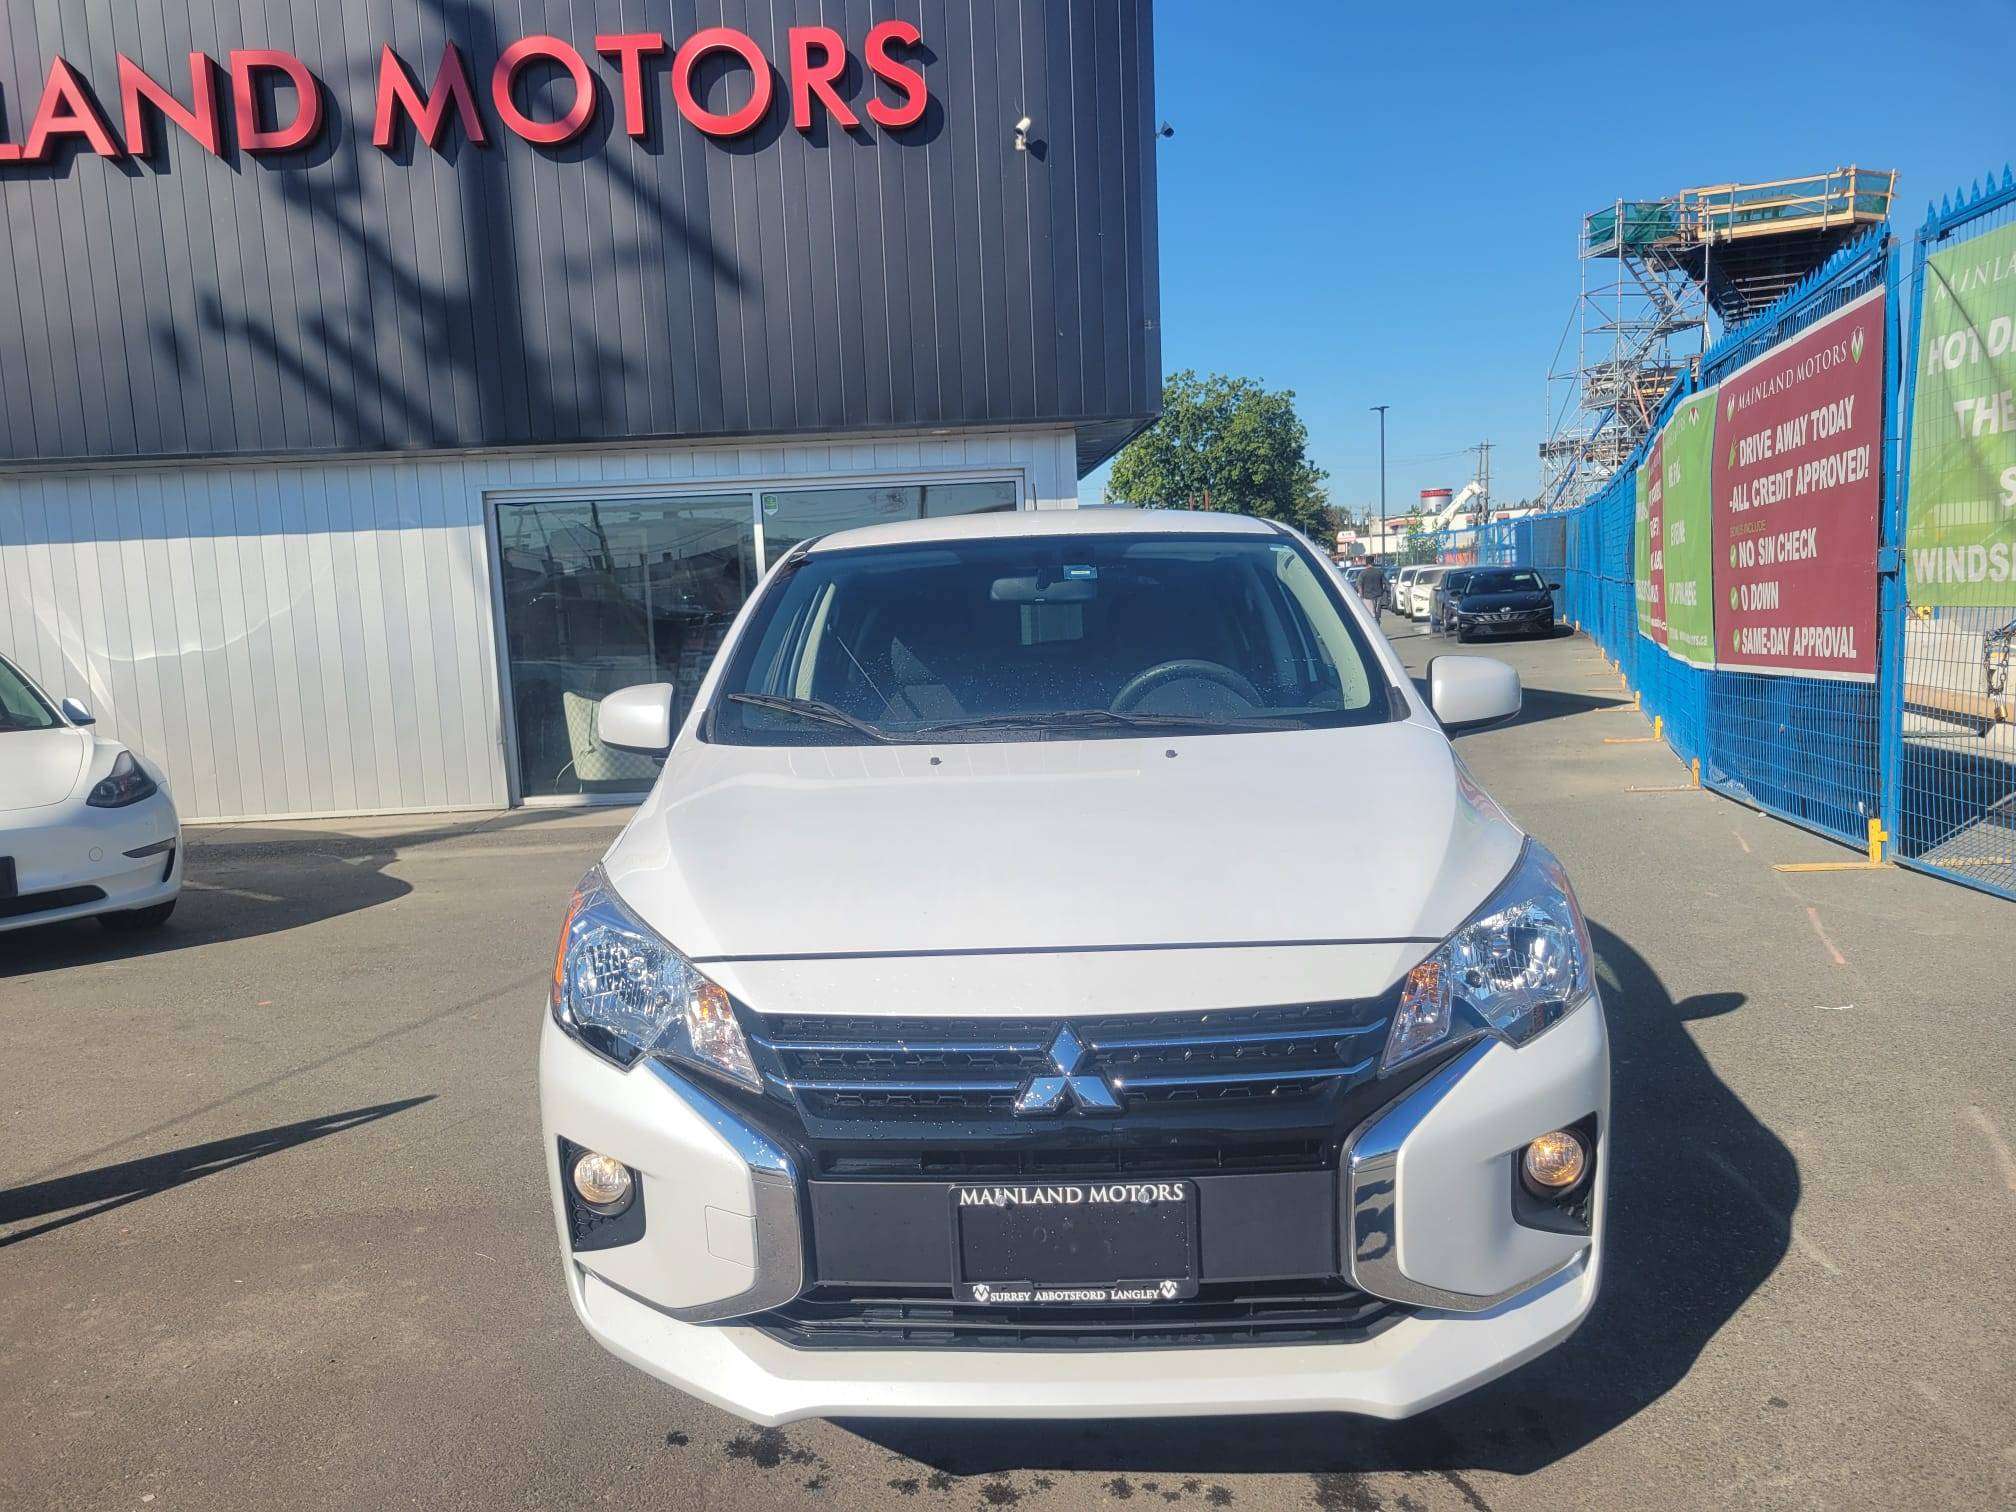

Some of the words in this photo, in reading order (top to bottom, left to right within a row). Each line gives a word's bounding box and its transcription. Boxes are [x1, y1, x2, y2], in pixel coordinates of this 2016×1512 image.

[373, 20, 928, 151] MOTORS
[1927, 326, 1978, 376] HOT
[1987, 316, 2016, 358] D
[1737, 369, 1793, 412] MAINLAND
[1796, 340, 1848, 384] MOTORS
[1739, 428, 1773, 467] DRIVE
[1775, 413, 1809, 455] AWAY
[1811, 394, 1855, 442] TODAY
[1751, 468, 1794, 508] CREDIT
[1795, 443, 1870, 497] APPROVED!
[1738, 538, 1755, 568] NO
[1758, 535, 1776, 566] SIN
[1777, 527, 1818, 563] CHECK
[1912, 543, 2016, 583] WINDS
[1750, 580, 1779, 611] DOWN
[1741, 626, 1791, 656] SAME-DAY
[1792, 626, 1857, 659] APPROVAL
[959, 1186, 1082, 1206] MAINLAND
[1088, 1183, 1184, 1203] MOTORS
[990, 1290, 1031, 1302] SURREY
[1034, 1288, 1106, 1301] ABBOTSFORD
[1110, 1287, 1160, 1300] LANGLEY
